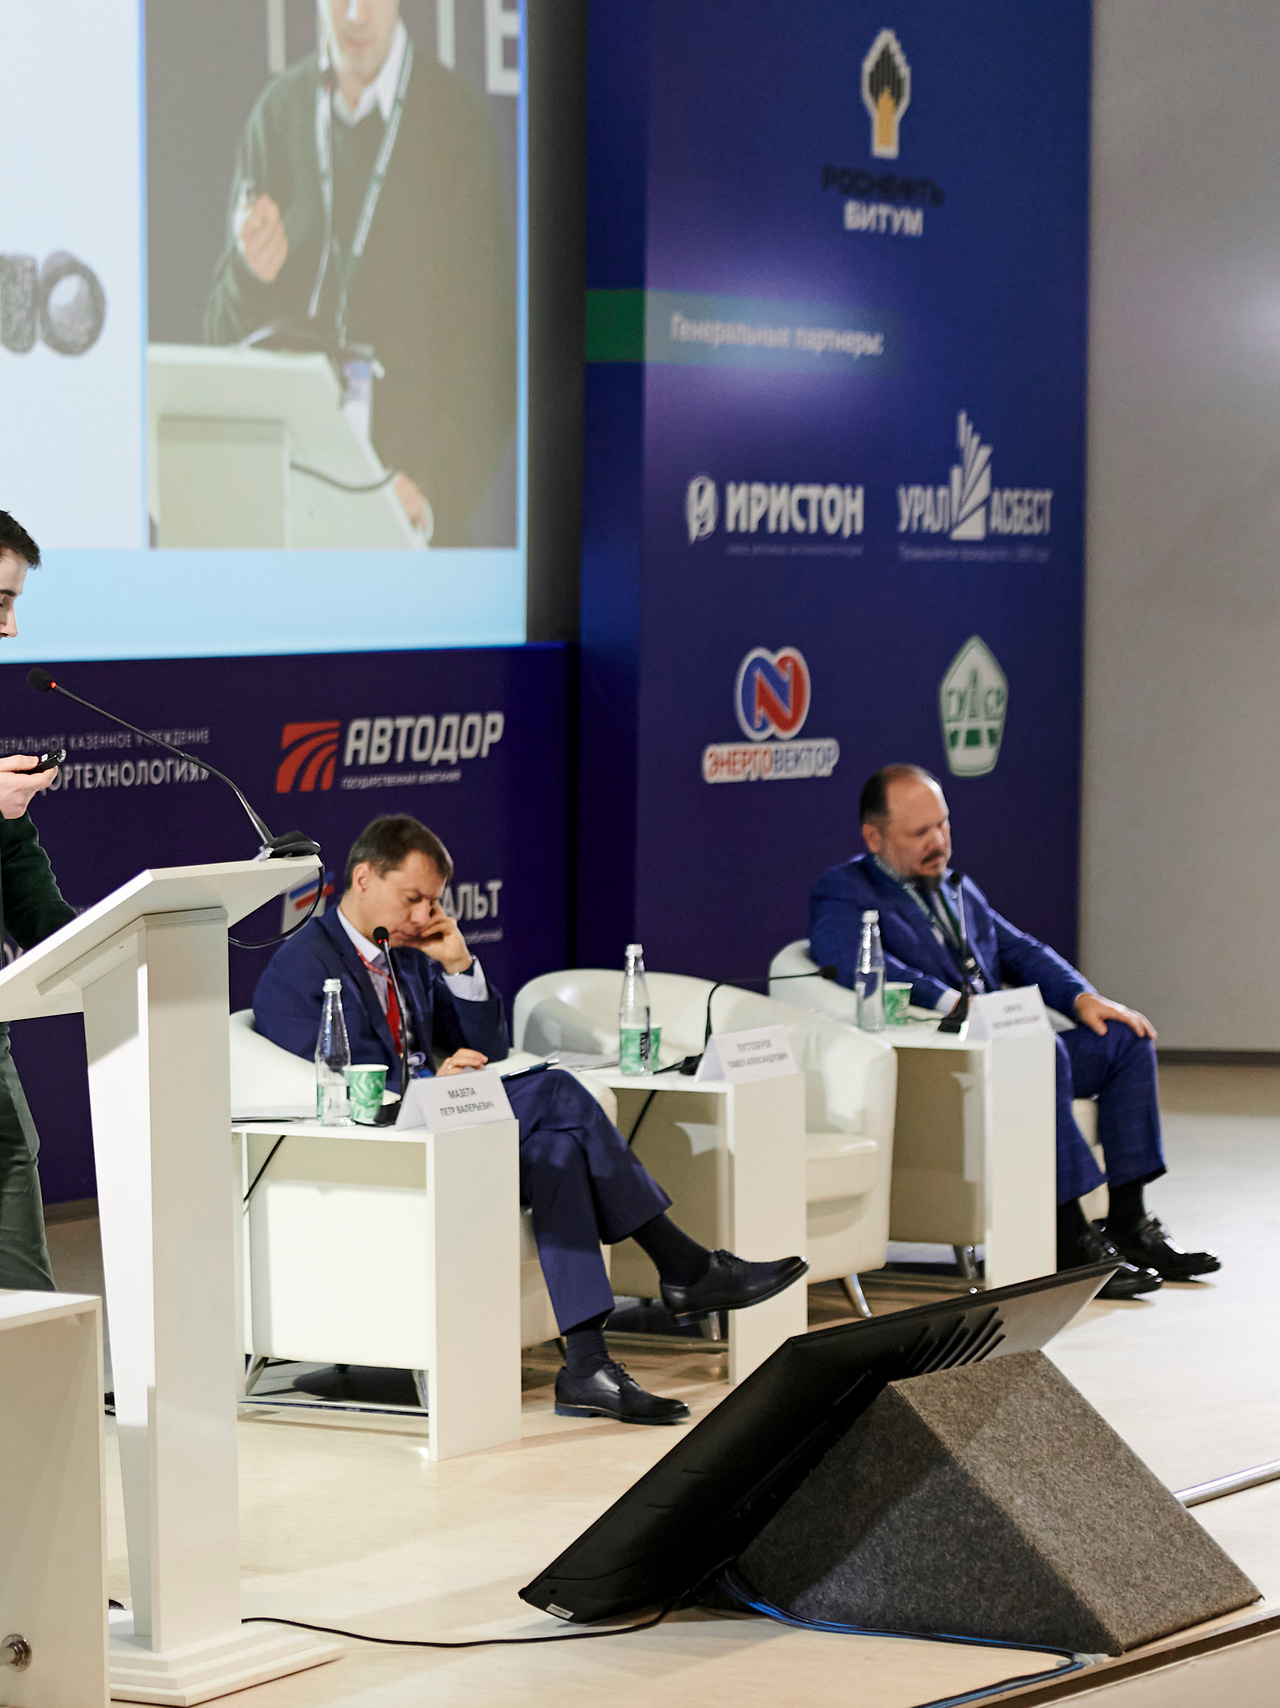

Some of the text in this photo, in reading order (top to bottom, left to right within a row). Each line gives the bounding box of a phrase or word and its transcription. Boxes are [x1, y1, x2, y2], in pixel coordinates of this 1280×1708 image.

[671, 311, 792, 348] Генеральные
[725, 481, 865, 538] ИРИСТОН
[897, 484, 951, 534] УРАЛ
[70, 733, 132, 750] КАЗЕННОЕ
[343, 711, 506, 767] АВТОДОР
[40, 757, 210, 797] ОРТЕХНОЛОГИЯ»
[706, 745, 838, 778] ЭНЕРГОВЕКТОР
[440, 1106, 456, 1117] ПЕТР
[448, 1087, 477, 1099] МАЗЕПА
